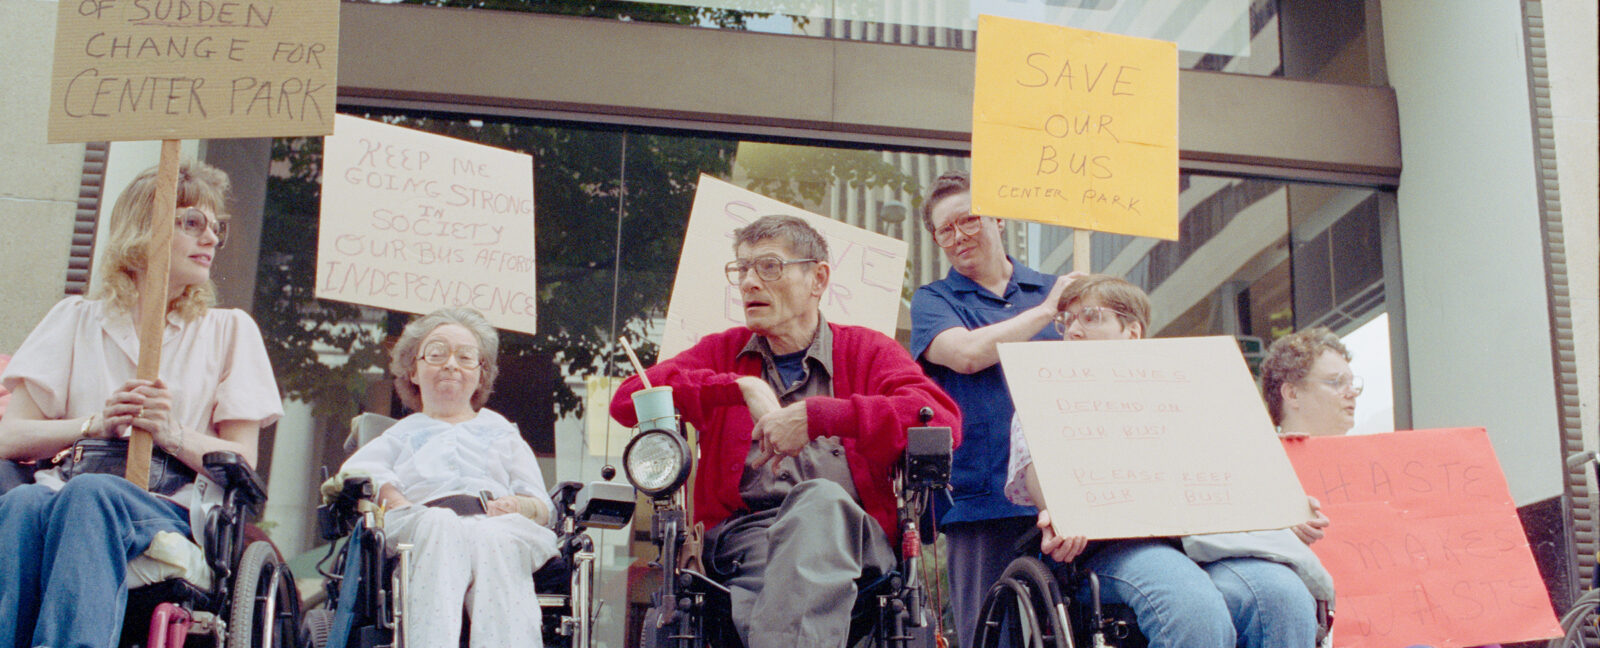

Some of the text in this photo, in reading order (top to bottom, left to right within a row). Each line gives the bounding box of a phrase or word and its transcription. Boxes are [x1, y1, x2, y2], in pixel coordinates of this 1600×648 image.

[79, 0, 274, 27] OF SUDDEN
[85, 32, 326, 69] CHANGE FOR
[1016, 52, 1142, 96] SAVE
[64, 68, 327, 121] CENTER PARK
[1044, 114, 1120, 143] OUR
[357, 138, 491, 178] KEEP ME
[1036, 145, 1113, 179] BUS
[344, 167, 531, 215] GOING STRONG
[998, 185, 1141, 216] CENTER PARK
[371, 208, 504, 246] SOCIETY
[418, 204, 446, 219] IN
[335, 234, 407, 260] OUR
[413, 241, 465, 264] BUS
[724, 200, 897, 293] SVE
[321, 261, 536, 317] INDEPENDENCE
[1037, 367, 1188, 381] OUR LIVES
[1056, 398, 1183, 413] DEPEND ON
[1062, 425, 1105, 438] OUR
[1073, 468, 1233, 482] PLEASE KEEP
[1319, 460, 1491, 504] HASTE
[1085, 489, 1133, 503] OUR
[1343, 529, 1519, 569] MAKES
[1345, 577, 1538, 638] WASTE
